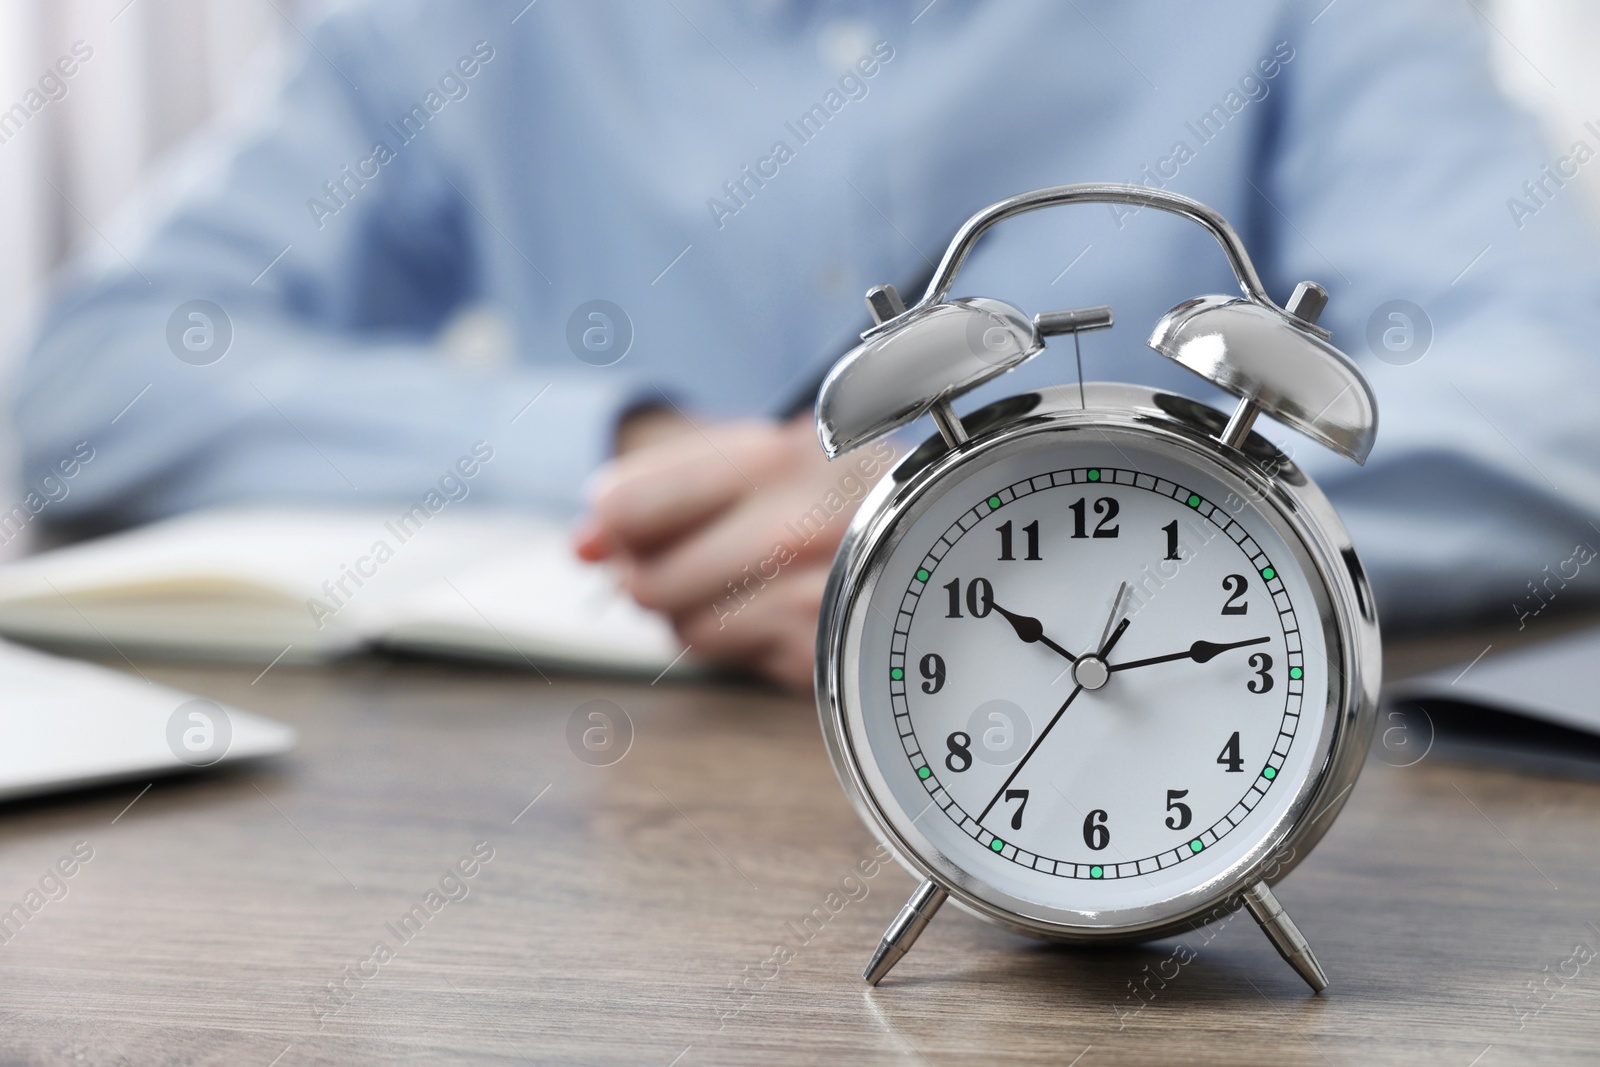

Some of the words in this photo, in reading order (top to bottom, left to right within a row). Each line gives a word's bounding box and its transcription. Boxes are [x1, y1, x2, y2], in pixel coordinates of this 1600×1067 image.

[1068, 496, 1119, 539] 12
[996, 519, 1042, 561] 11
[1162, 520, 1182, 560] 1
[943, 577, 994, 618] 10
[1221, 574, 1248, 615] 2
[919, 653, 946, 694] 9
[1247, 653, 1273, 694] 3
[945, 731, 972, 772] 8
[1217, 732, 1244, 772] 4
[1004, 789, 1029, 830] 7
[1083, 809, 1109, 850] 6
[1165, 790, 1192, 830] 5
